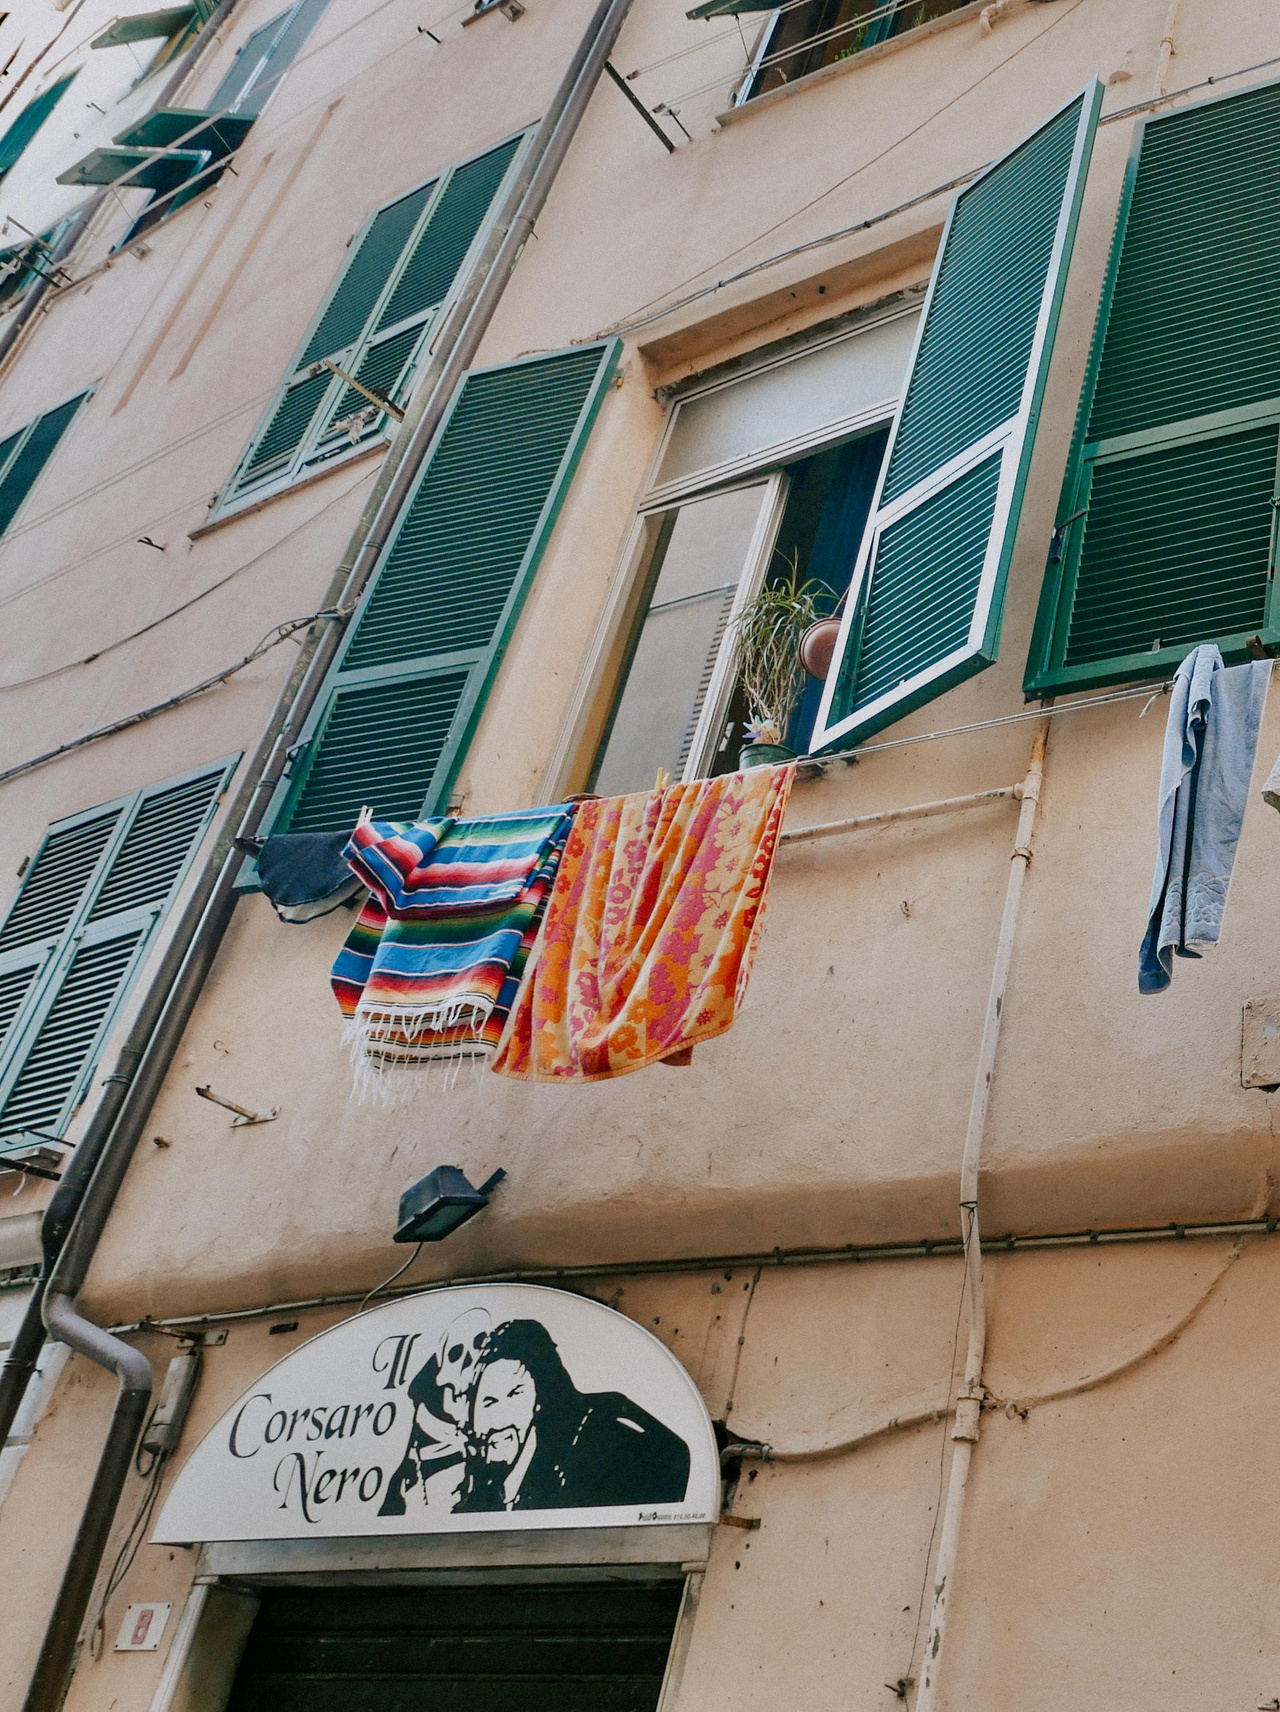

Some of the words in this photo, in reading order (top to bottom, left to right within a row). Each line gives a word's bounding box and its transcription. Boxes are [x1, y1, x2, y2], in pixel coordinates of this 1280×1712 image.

[372, 1333, 421, 1391] Il
[229, 1393, 397, 1458] Corsaro
[273, 1450, 383, 1524] Nero
